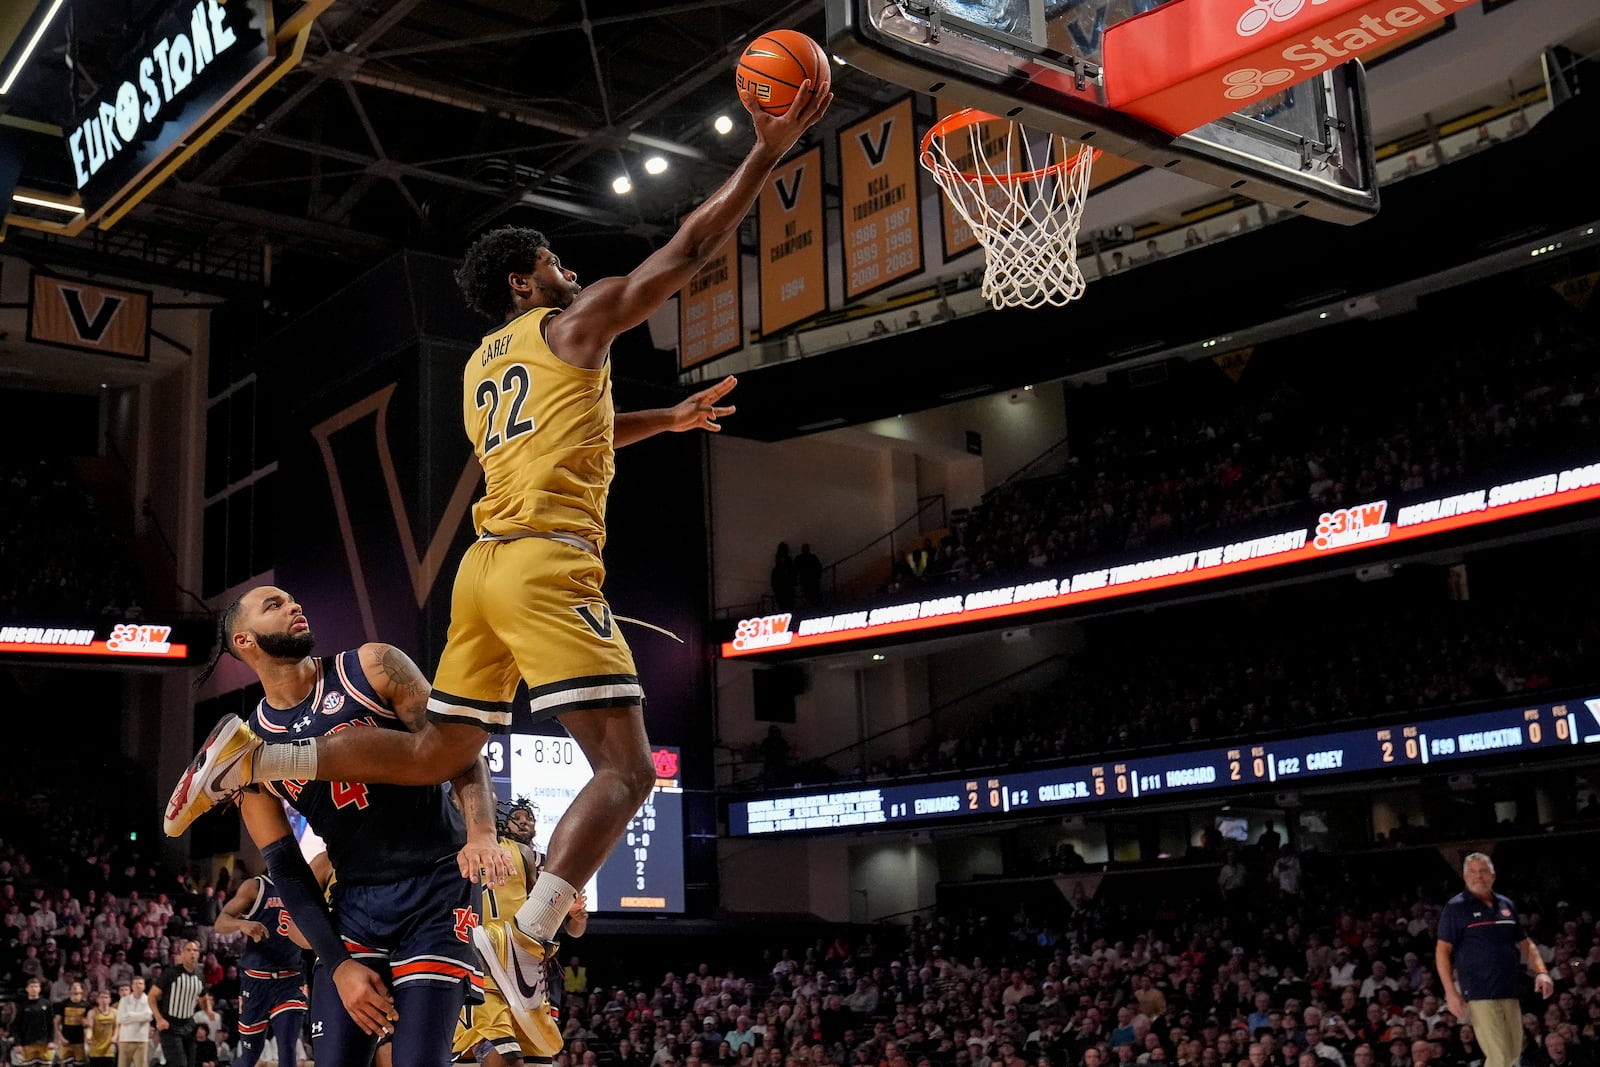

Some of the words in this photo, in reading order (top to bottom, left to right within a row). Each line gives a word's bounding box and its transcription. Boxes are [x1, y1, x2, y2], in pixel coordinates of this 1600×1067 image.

[1282, 7, 1425, 71] State
[737, 73, 771, 98] ELITE
[857, 117, 895, 169] V
[773, 165, 805, 213] V
[867, 175, 890, 196] NCAA
[852, 183, 907, 223] TOURNAMENT
[884, 207, 911, 232] 1987
[771, 230, 813, 263] CHAMPIONS
[852, 243, 878, 268] 1989
[886, 228, 912, 253] 1998
[886, 249, 914, 274] 2003
[58, 285, 127, 345] V
[481, 333, 513, 367] CAREY
[474, 363, 535, 457] 22
[569, 602, 613, 640] V
[1528, 722, 1542, 743] 0
[1555, 718, 1568, 740] 0
[534, 740, 573, 765] 8:30
[1278, 758, 1300, 775] #22
[1306, 749, 1344, 771] CAREY
[1381, 742, 1394, 762] 2
[1405, 739, 1418, 760] 0
[1038, 783, 1075, 802] COLLINS
[1095, 777, 1106, 795] 5
[1116, 775, 1127, 793] 0
[1140, 775, 1161, 791] #11
[1166, 766, 1216, 788] HOGGARD
[1230, 761, 1241, 780] 2
[1253, 759, 1264, 778] 0
[331, 781, 369, 810] 4
[915, 796, 960, 815] EDWARDS
[968, 792, 978, 810] 2
[989, 790, 1000, 808] 0
[626, 833, 650, 847] 0-0
[634, 848, 647, 861] 10
[636, 862, 645, 875] 2
[636, 876, 645, 891] 3
[276, 909, 292, 936] 5
